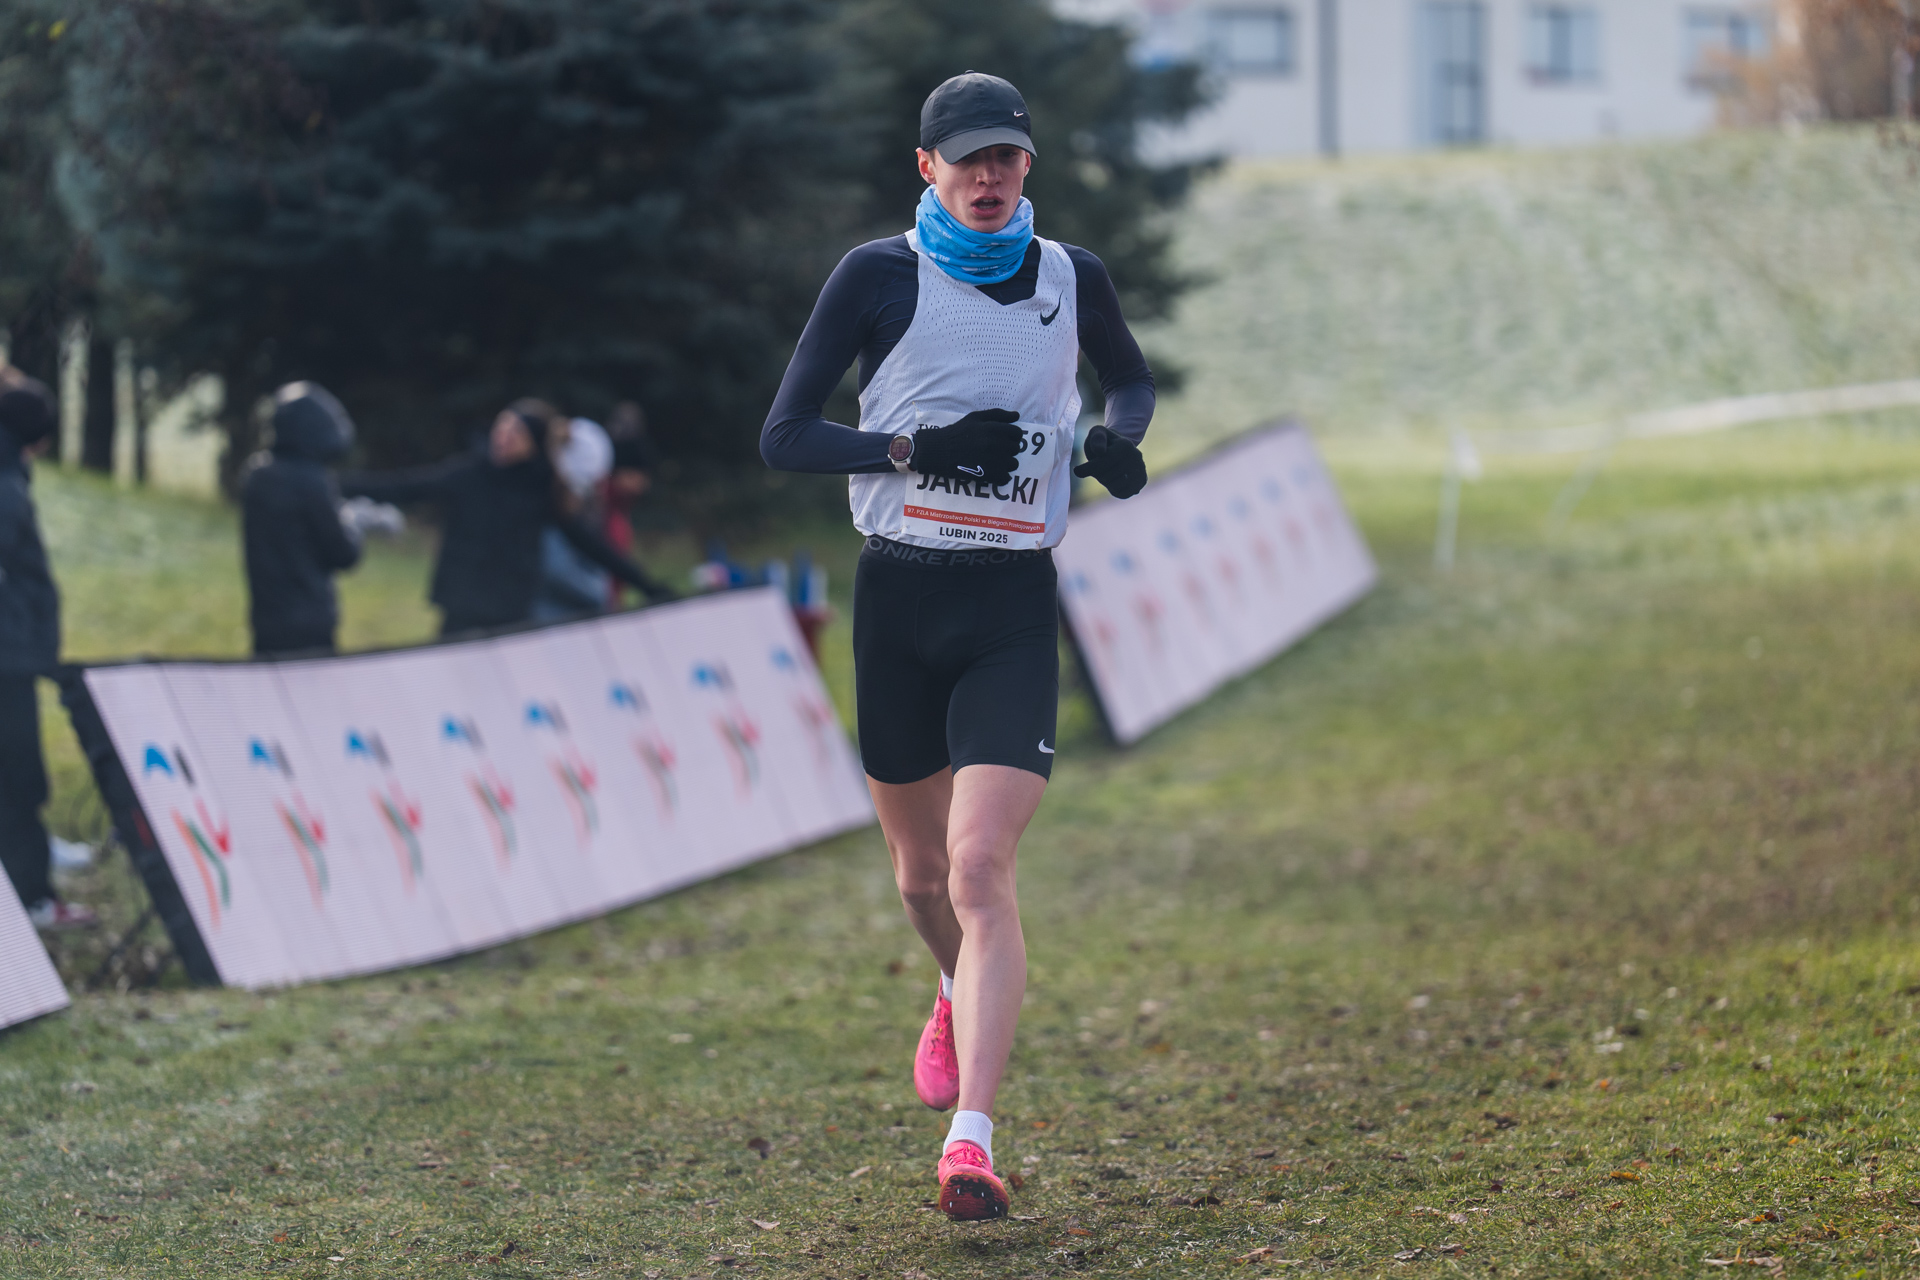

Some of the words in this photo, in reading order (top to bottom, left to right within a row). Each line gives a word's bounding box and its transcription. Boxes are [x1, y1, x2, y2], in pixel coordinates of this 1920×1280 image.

[916, 474, 1039, 505] JARECKI
[907, 507, 916, 515] 97.
[916, 509, 930, 517] PZLA
[930, 512, 963, 520] Mistrzostwa
[987, 518, 1009, 527] Biegach
[939, 526, 976, 541] LUBIN
[978, 531, 1008, 544] 2025
[882, 542, 947, 566] NIKE
[948, 550, 1010, 567] PRO
